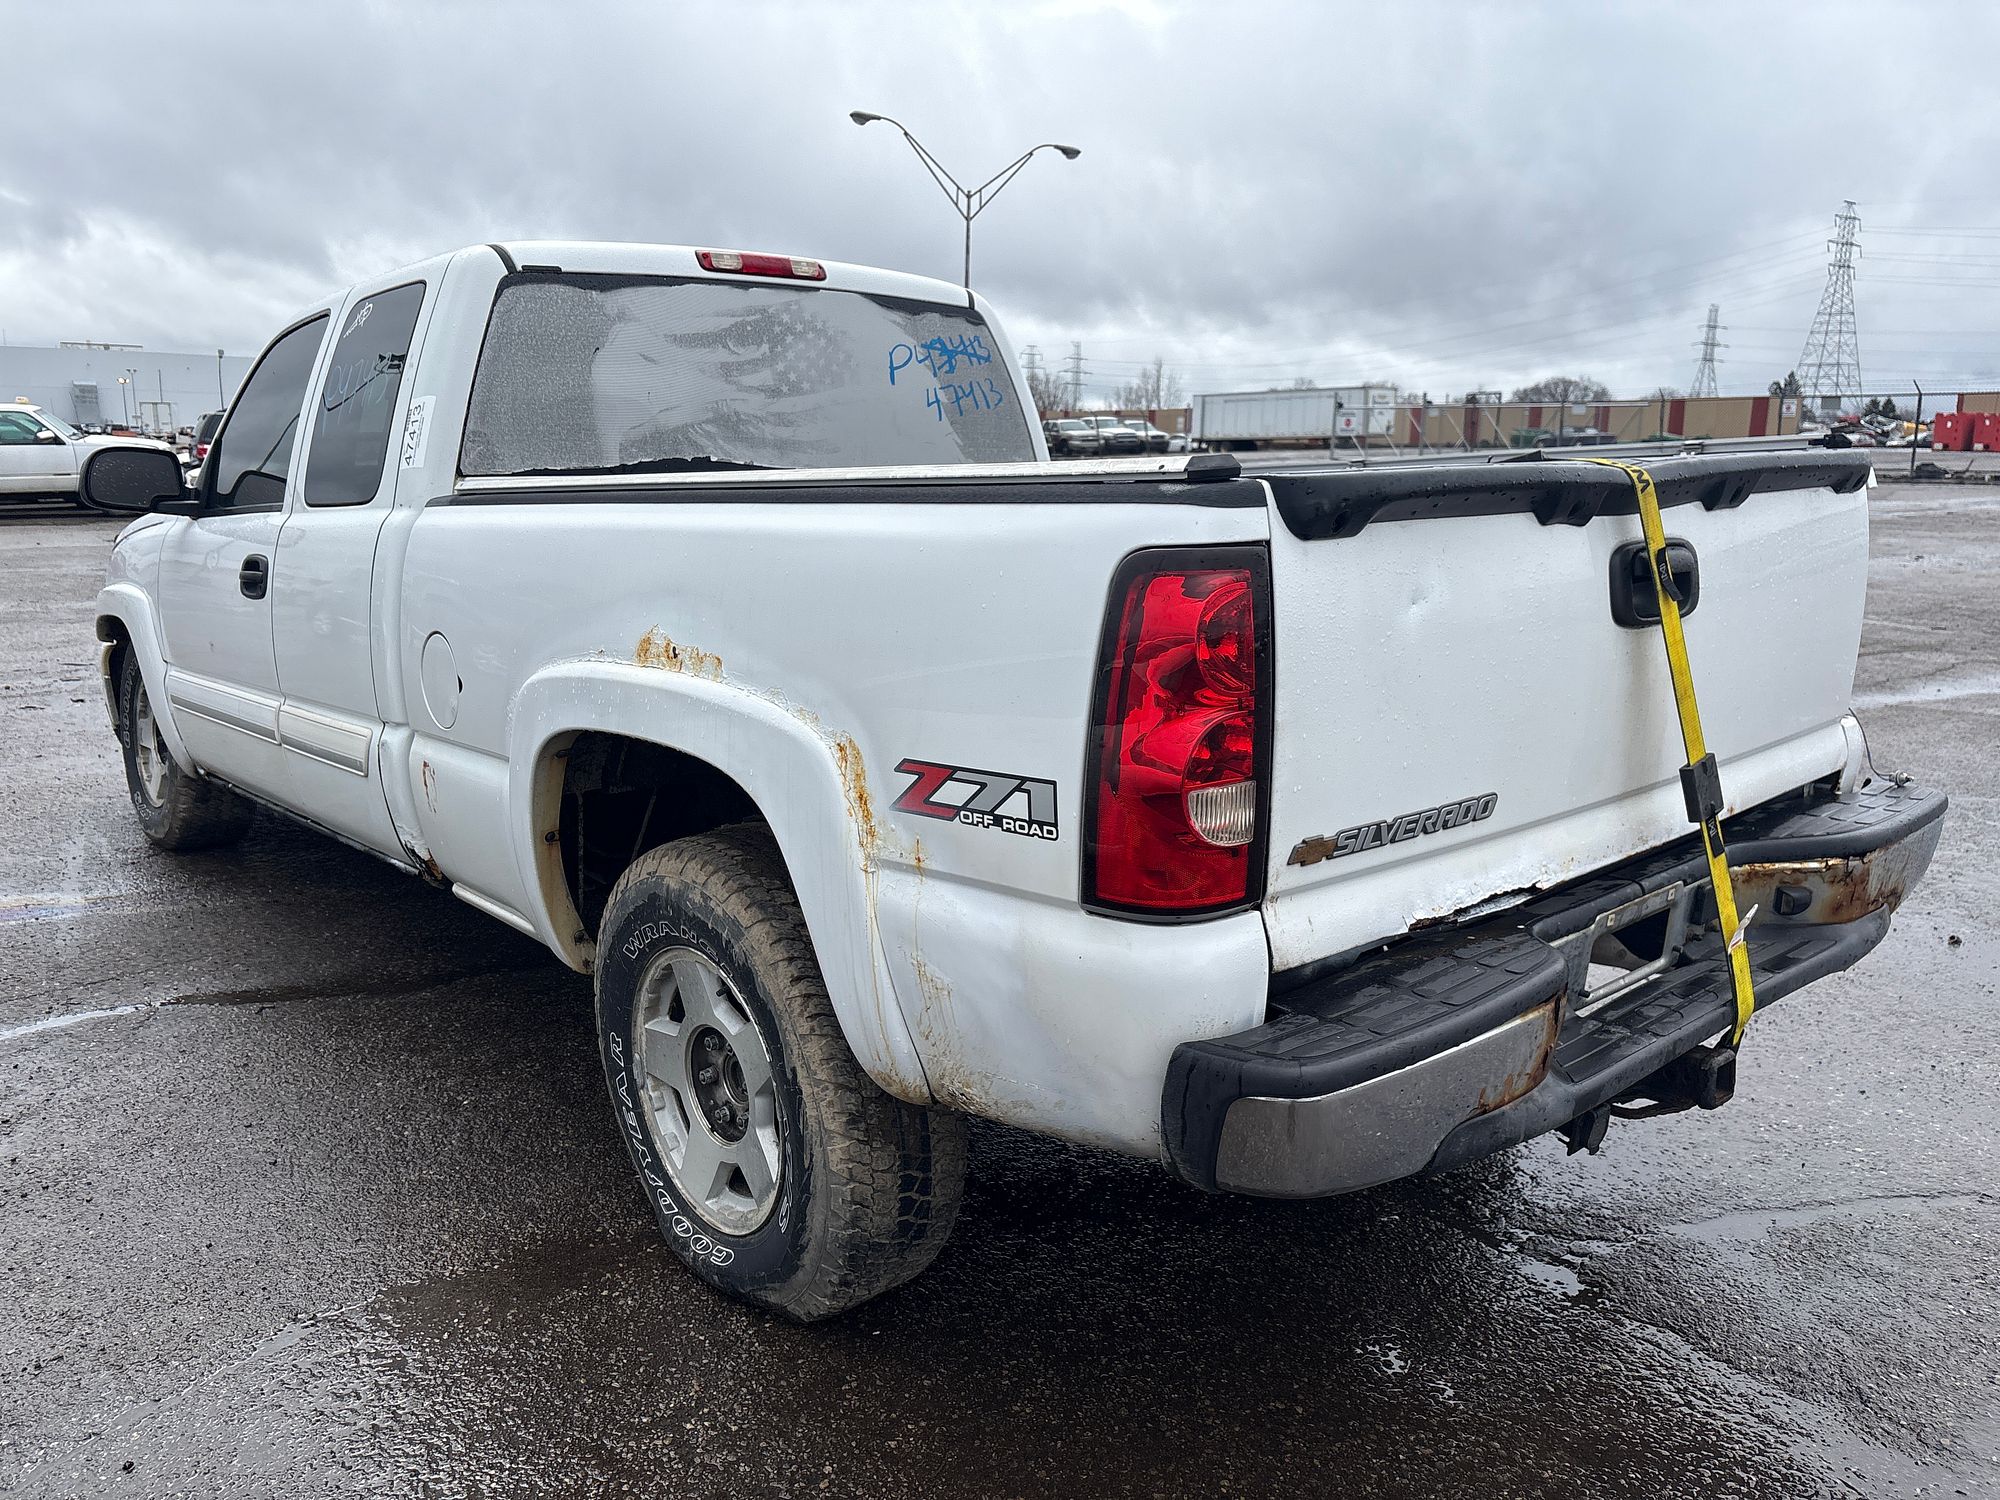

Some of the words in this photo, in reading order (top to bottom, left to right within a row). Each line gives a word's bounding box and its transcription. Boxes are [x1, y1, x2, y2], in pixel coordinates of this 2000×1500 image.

[926, 378, 1003, 422] 47413
[404, 404, 421, 467] 47413
[889, 758, 1058, 822] Z71
[959, 809, 994, 827] OFF
[1001, 817, 1058, 840] ROAD
[1328, 792, 1498, 860] SILVERADO
[609, 1031, 735, 1266] GOODYEAR
